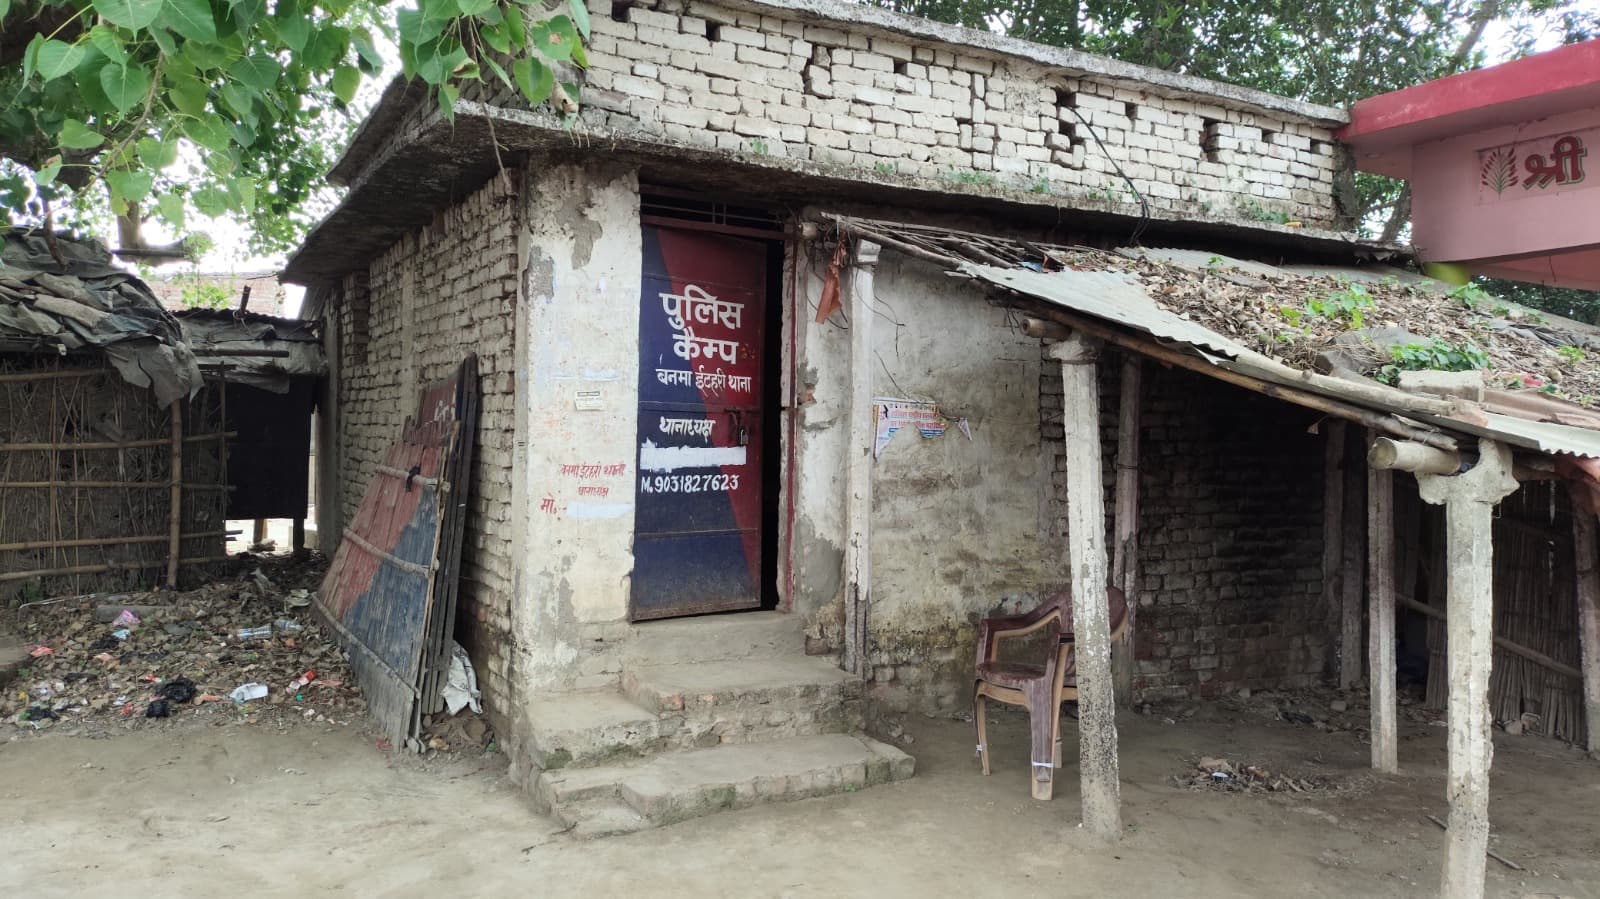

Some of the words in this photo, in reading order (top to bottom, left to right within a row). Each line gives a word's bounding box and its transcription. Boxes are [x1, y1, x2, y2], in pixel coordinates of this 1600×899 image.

[1522, 136, 1588, 190] श्री
[658, 284, 744, 330] पुलिस
[672, 326, 739, 365] कैम्प
[656, 368, 693, 387] बनमा
[728, 374, 752, 393] थाना
[658, 416, 716, 444] थानाध्यक्ष
